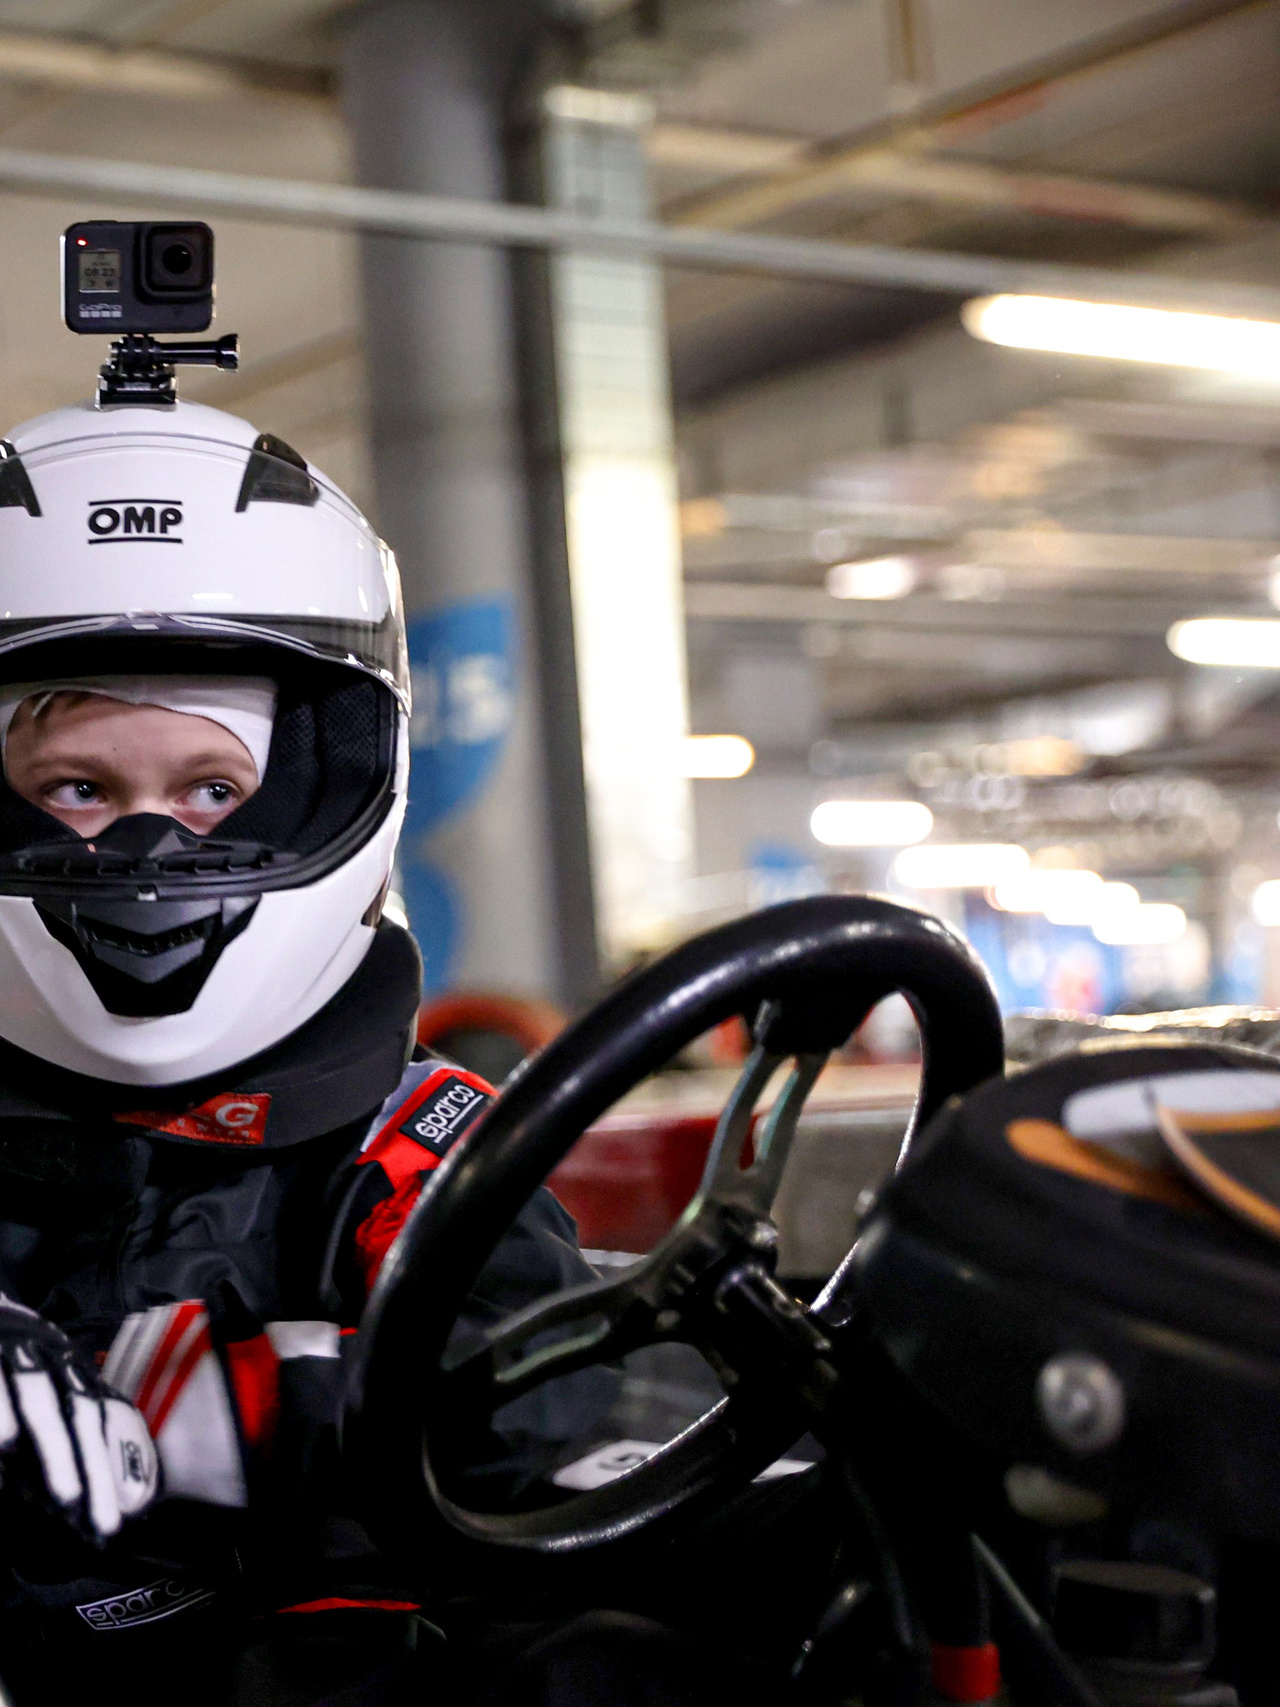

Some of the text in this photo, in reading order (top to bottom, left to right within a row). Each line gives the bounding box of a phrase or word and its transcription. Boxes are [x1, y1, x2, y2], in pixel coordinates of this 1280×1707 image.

[88, 506, 182, 535] OMP
[215, 1102, 259, 1128] G
[415, 1085, 479, 1140] sparco
